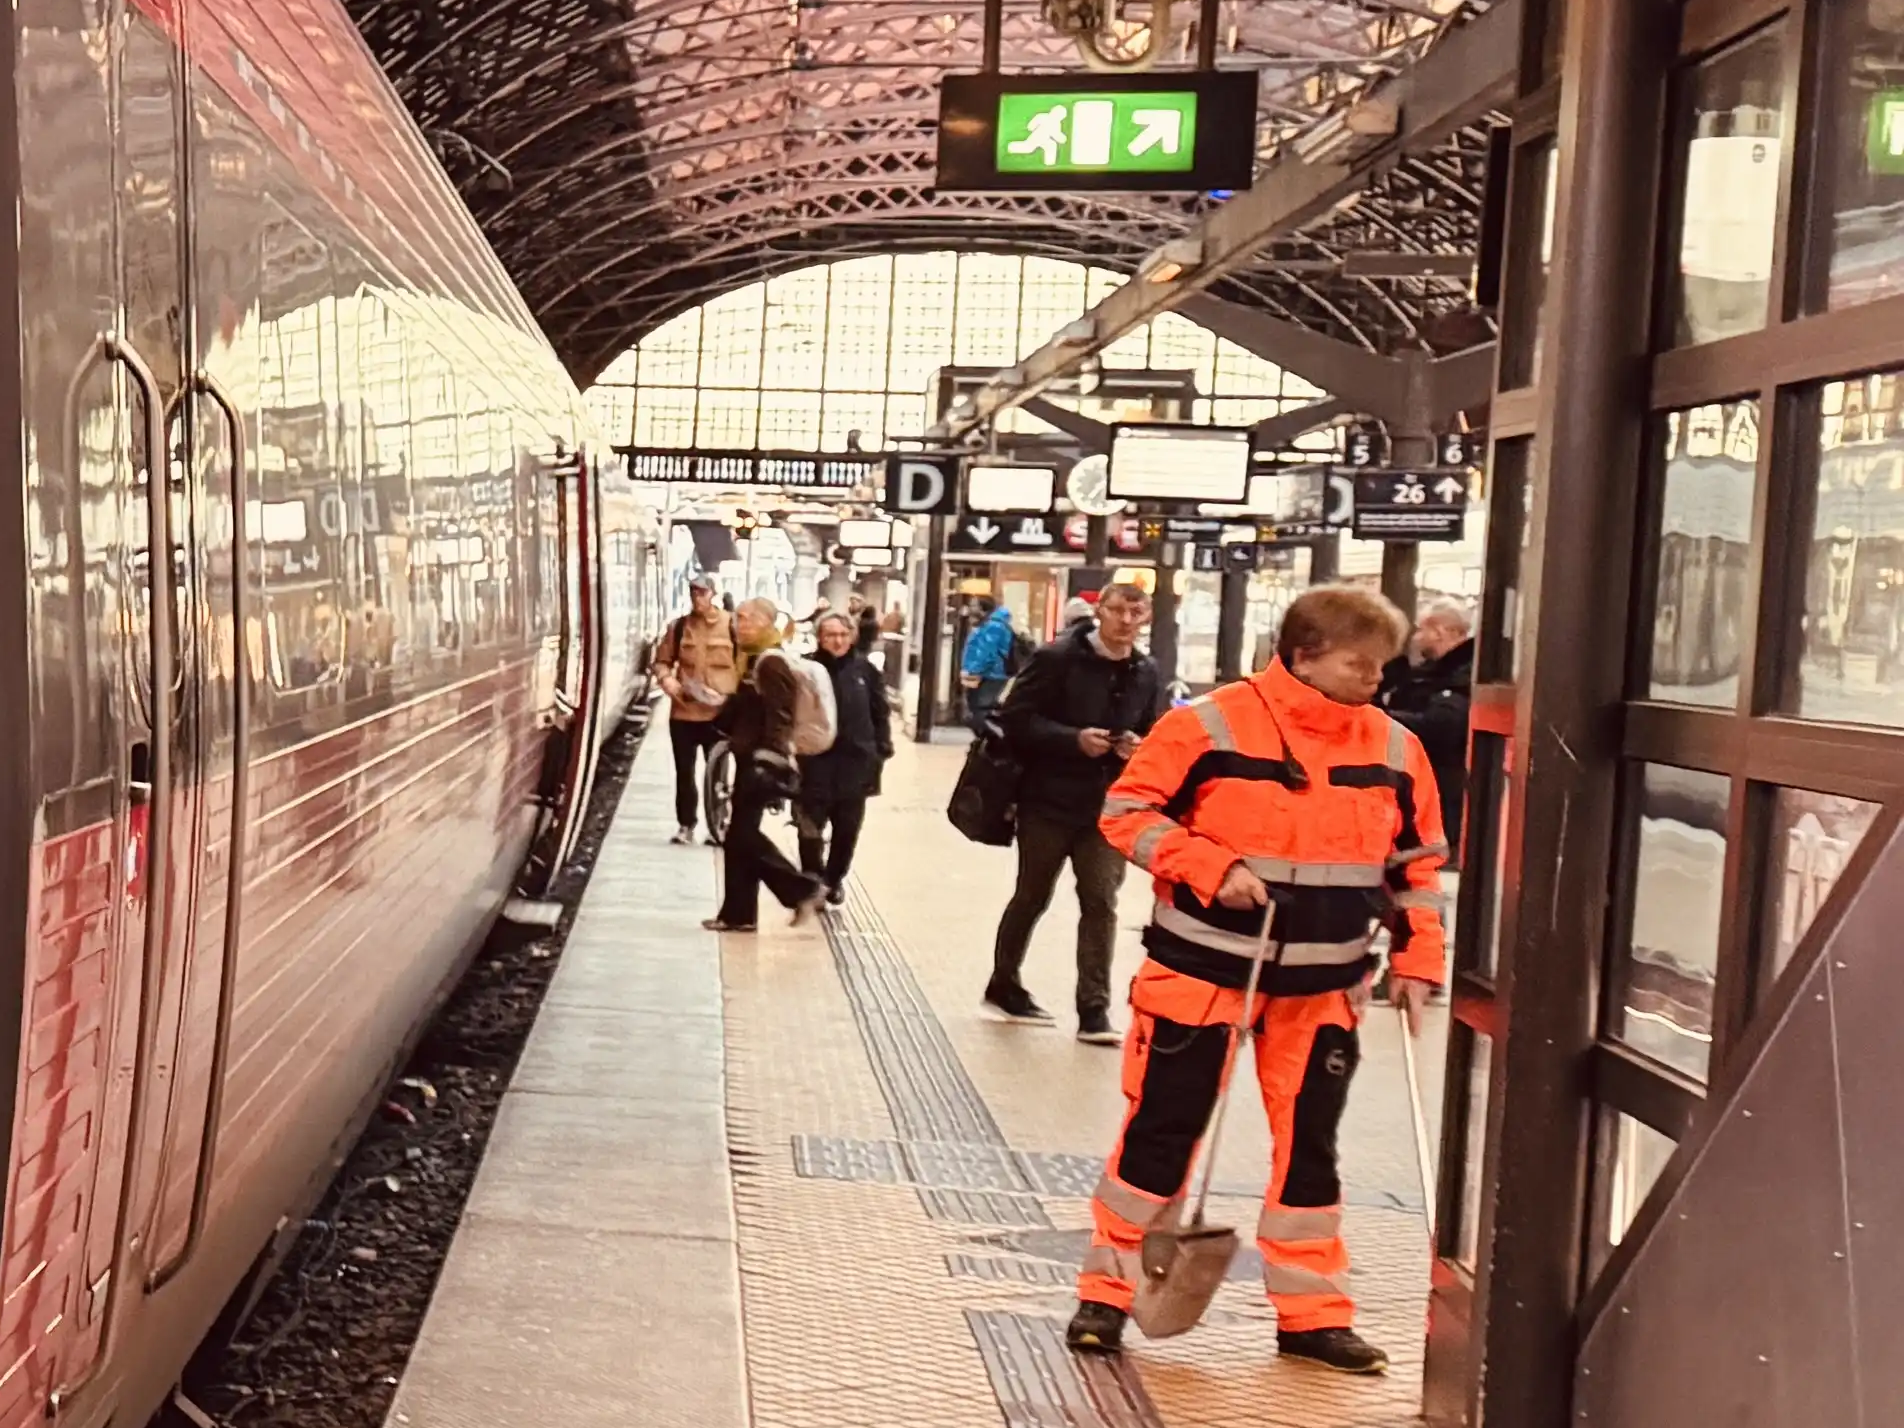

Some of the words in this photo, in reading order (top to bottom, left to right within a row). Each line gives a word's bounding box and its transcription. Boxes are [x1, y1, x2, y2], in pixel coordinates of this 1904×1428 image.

[1352, 444, 1371, 465] 5
[1445, 443, 1464, 465] 6
[898, 462, 945, 511] D
[1392, 483, 1426, 505] 26
